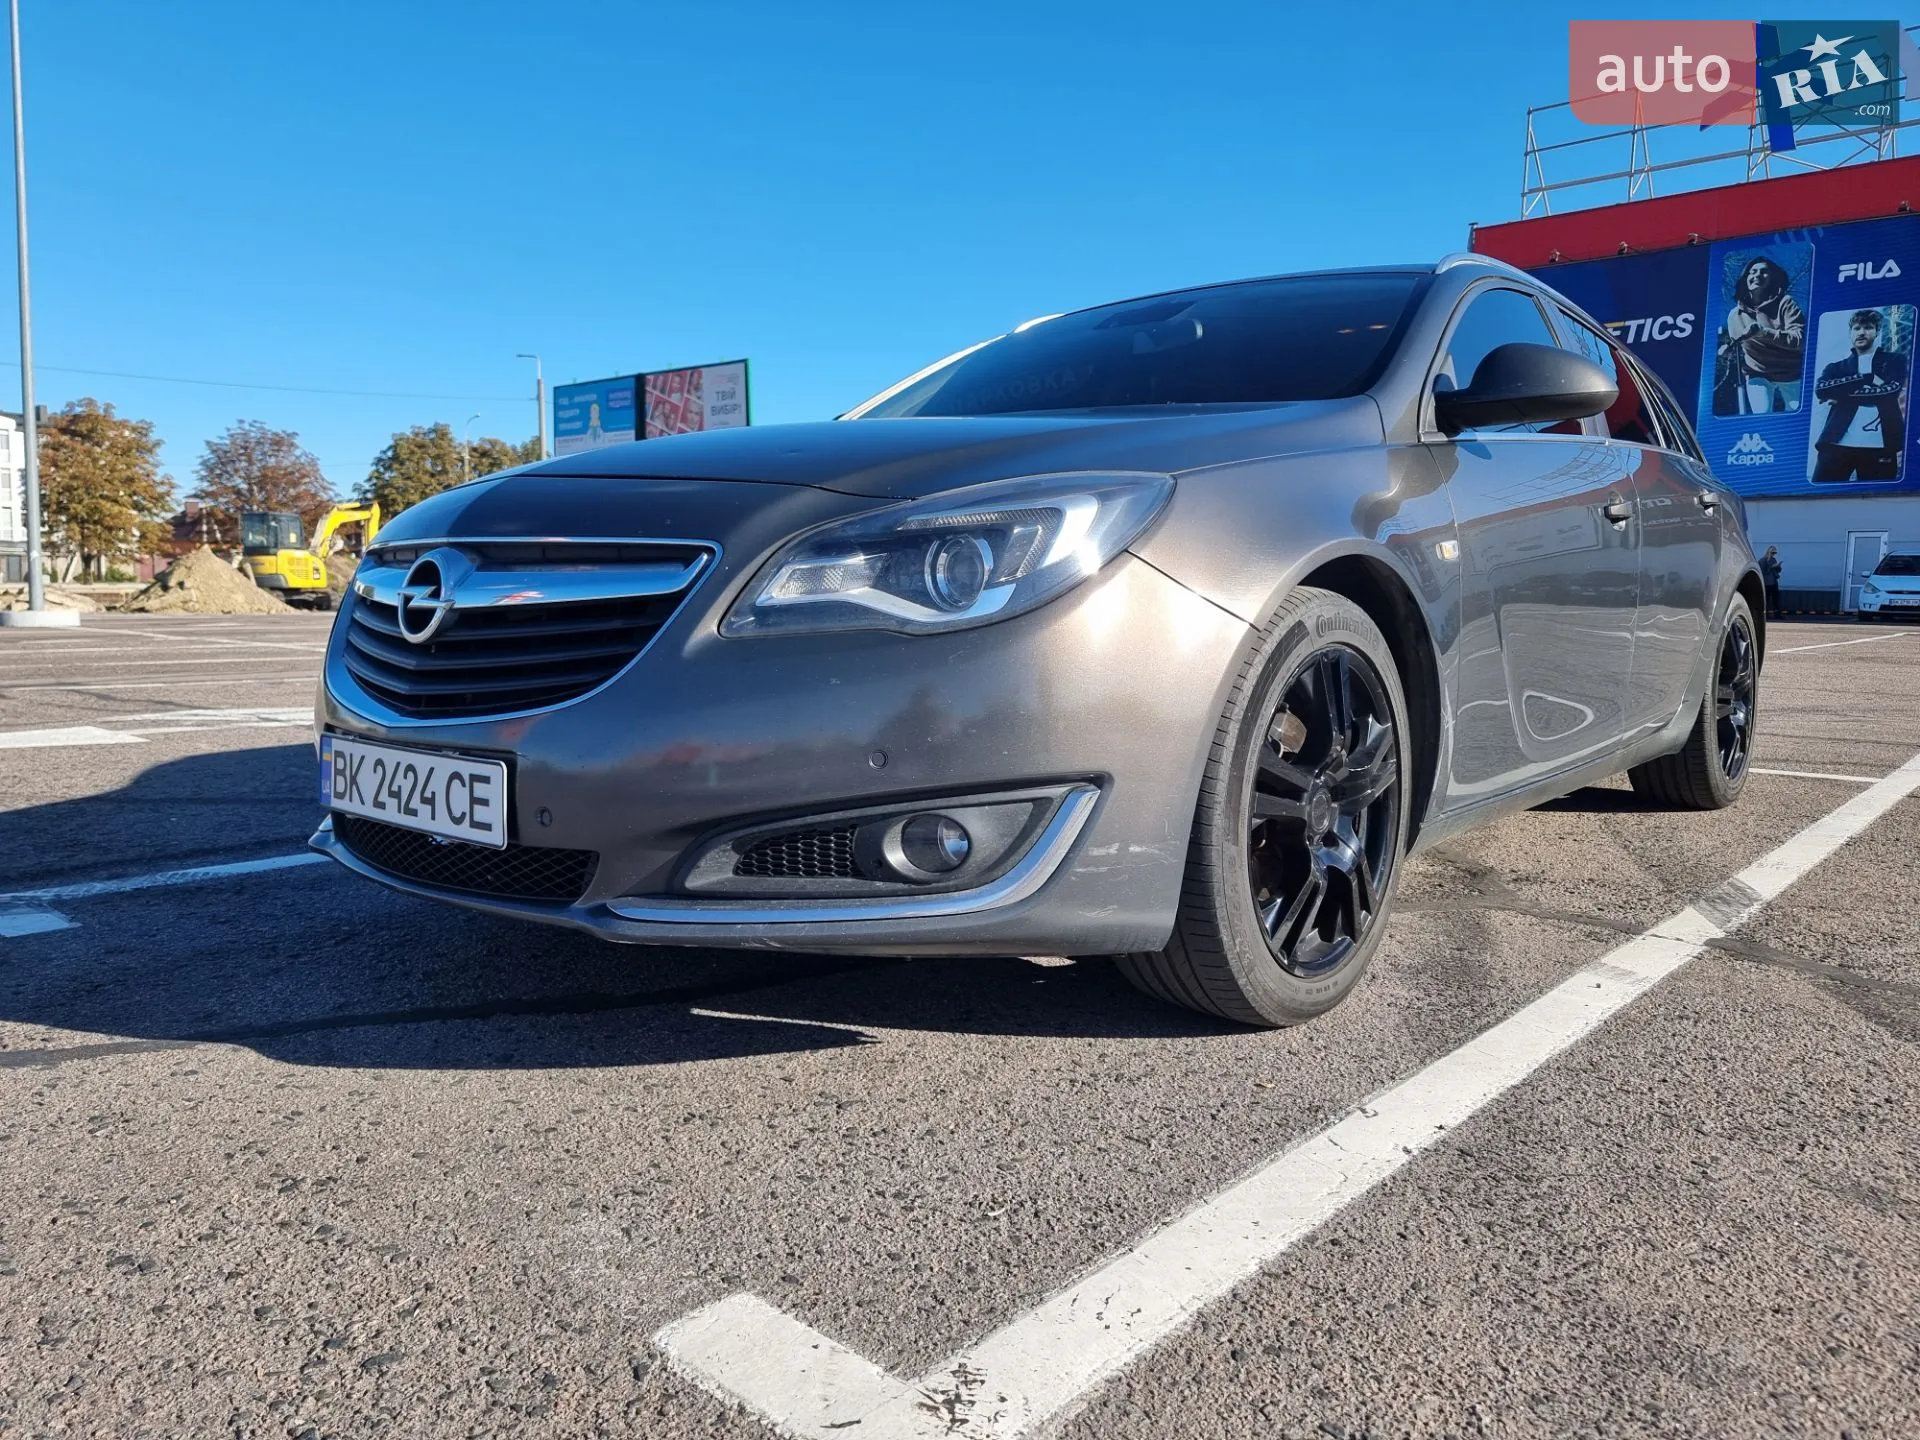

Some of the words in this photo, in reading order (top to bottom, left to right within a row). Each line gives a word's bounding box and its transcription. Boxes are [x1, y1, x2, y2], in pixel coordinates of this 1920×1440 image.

[1838, 259, 1901, 283] FILA
[1727, 453, 1775, 468] Kappa
[333, 750, 366, 806] BK
[372, 757, 436, 821] 2424
[445, 770, 493, 832] CE
